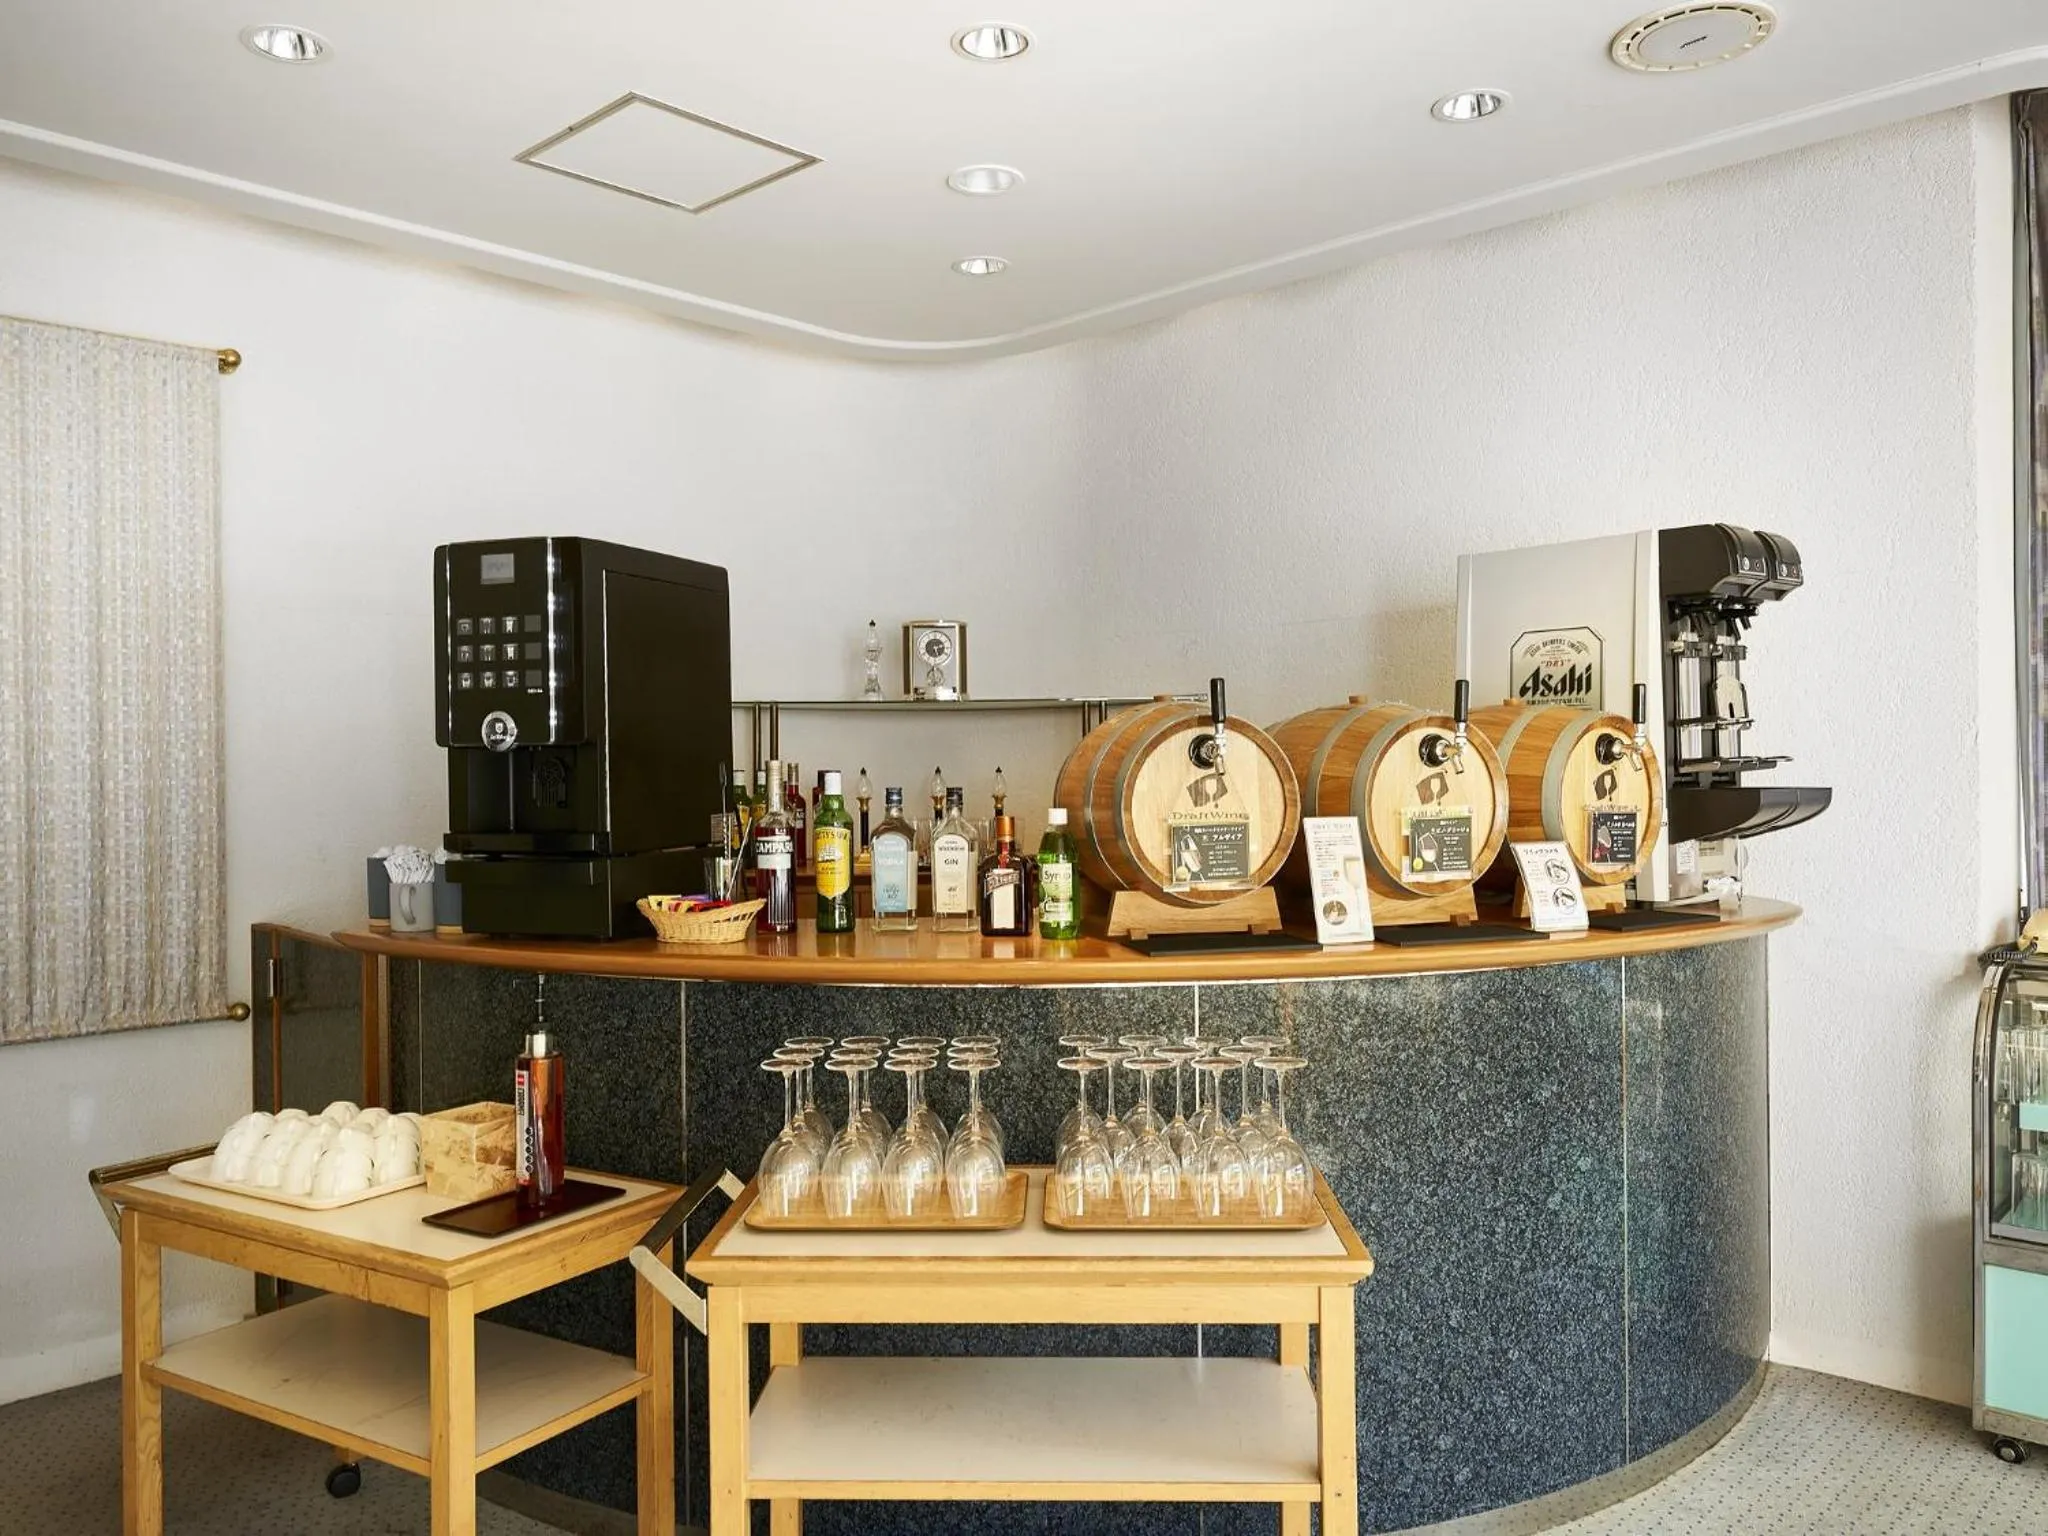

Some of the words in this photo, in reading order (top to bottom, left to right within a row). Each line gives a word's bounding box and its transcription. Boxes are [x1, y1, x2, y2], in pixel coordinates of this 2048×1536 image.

[1519, 662, 1592, 698] Asahi
[755, 841, 794, 853] CAMPARI
[944, 858, 959, 866] GIN
